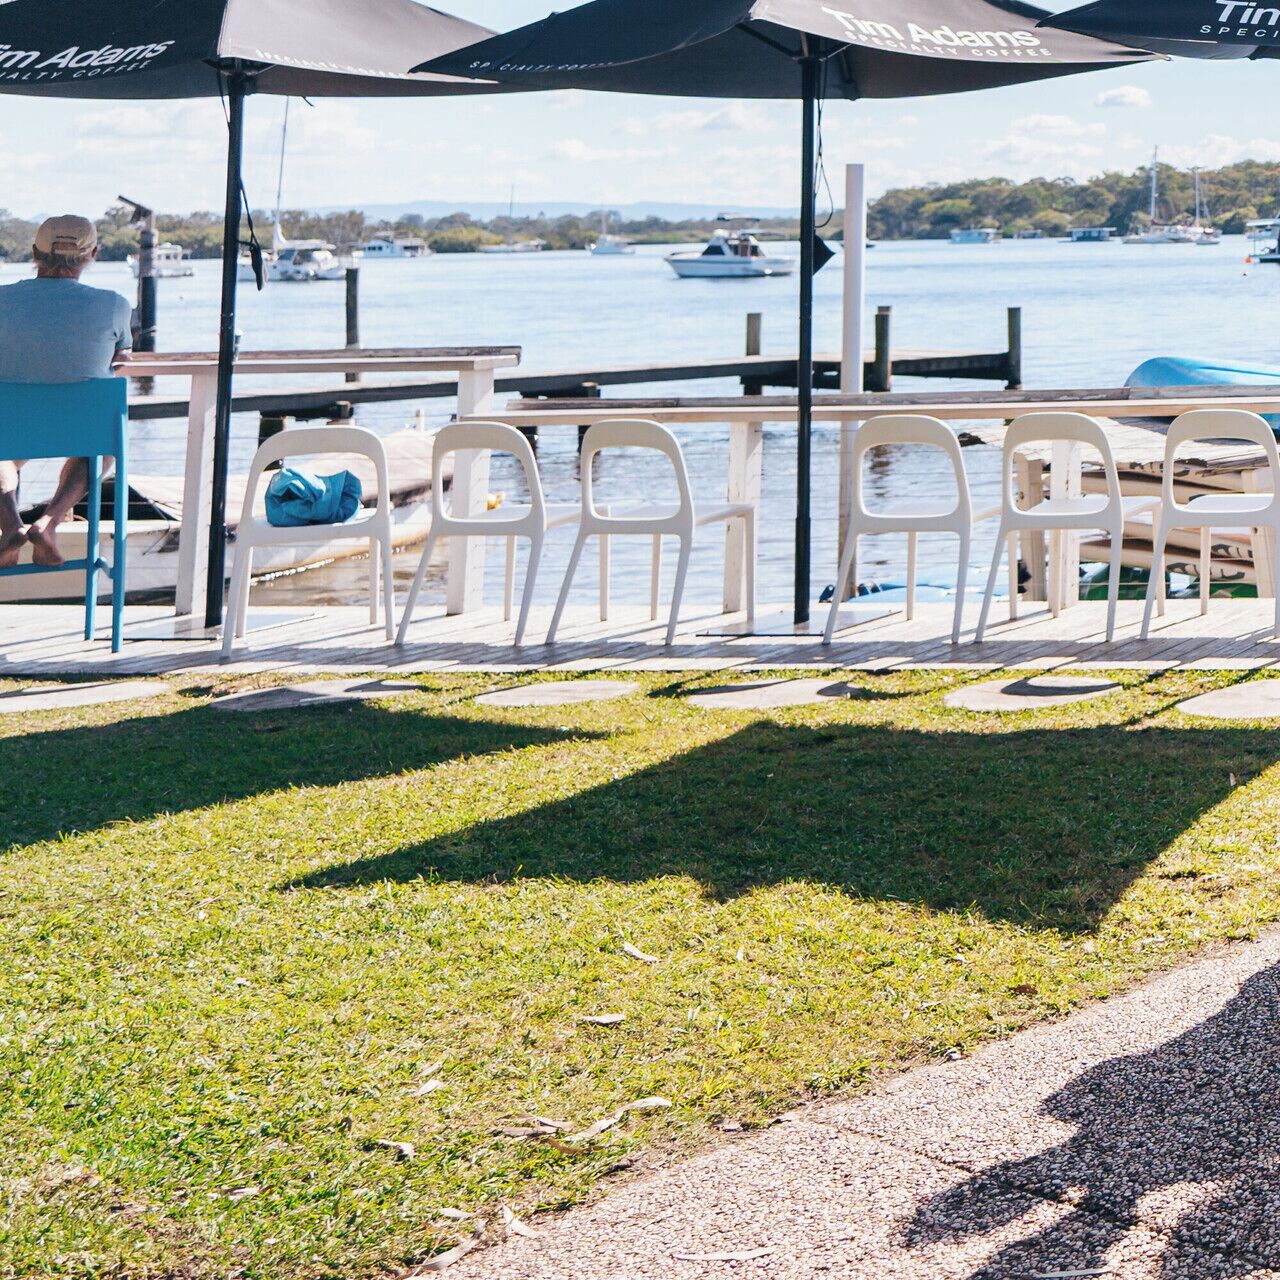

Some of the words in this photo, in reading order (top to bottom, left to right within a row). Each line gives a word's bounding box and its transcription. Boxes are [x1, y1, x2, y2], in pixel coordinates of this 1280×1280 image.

[821, 6, 904, 41] Tim
[906, 22, 1041, 48] Adams
[0, 44, 41, 69] im
[35, 40, 176, 69] Adams
[844, 30, 958, 57] SPECIALTY
[971, 48, 1053, 58] COFFEE
[0, 71, 63, 81] IALTY
[72, 59, 152, 78] COFFEE
[470, 60, 551, 72] SPCIALTY
